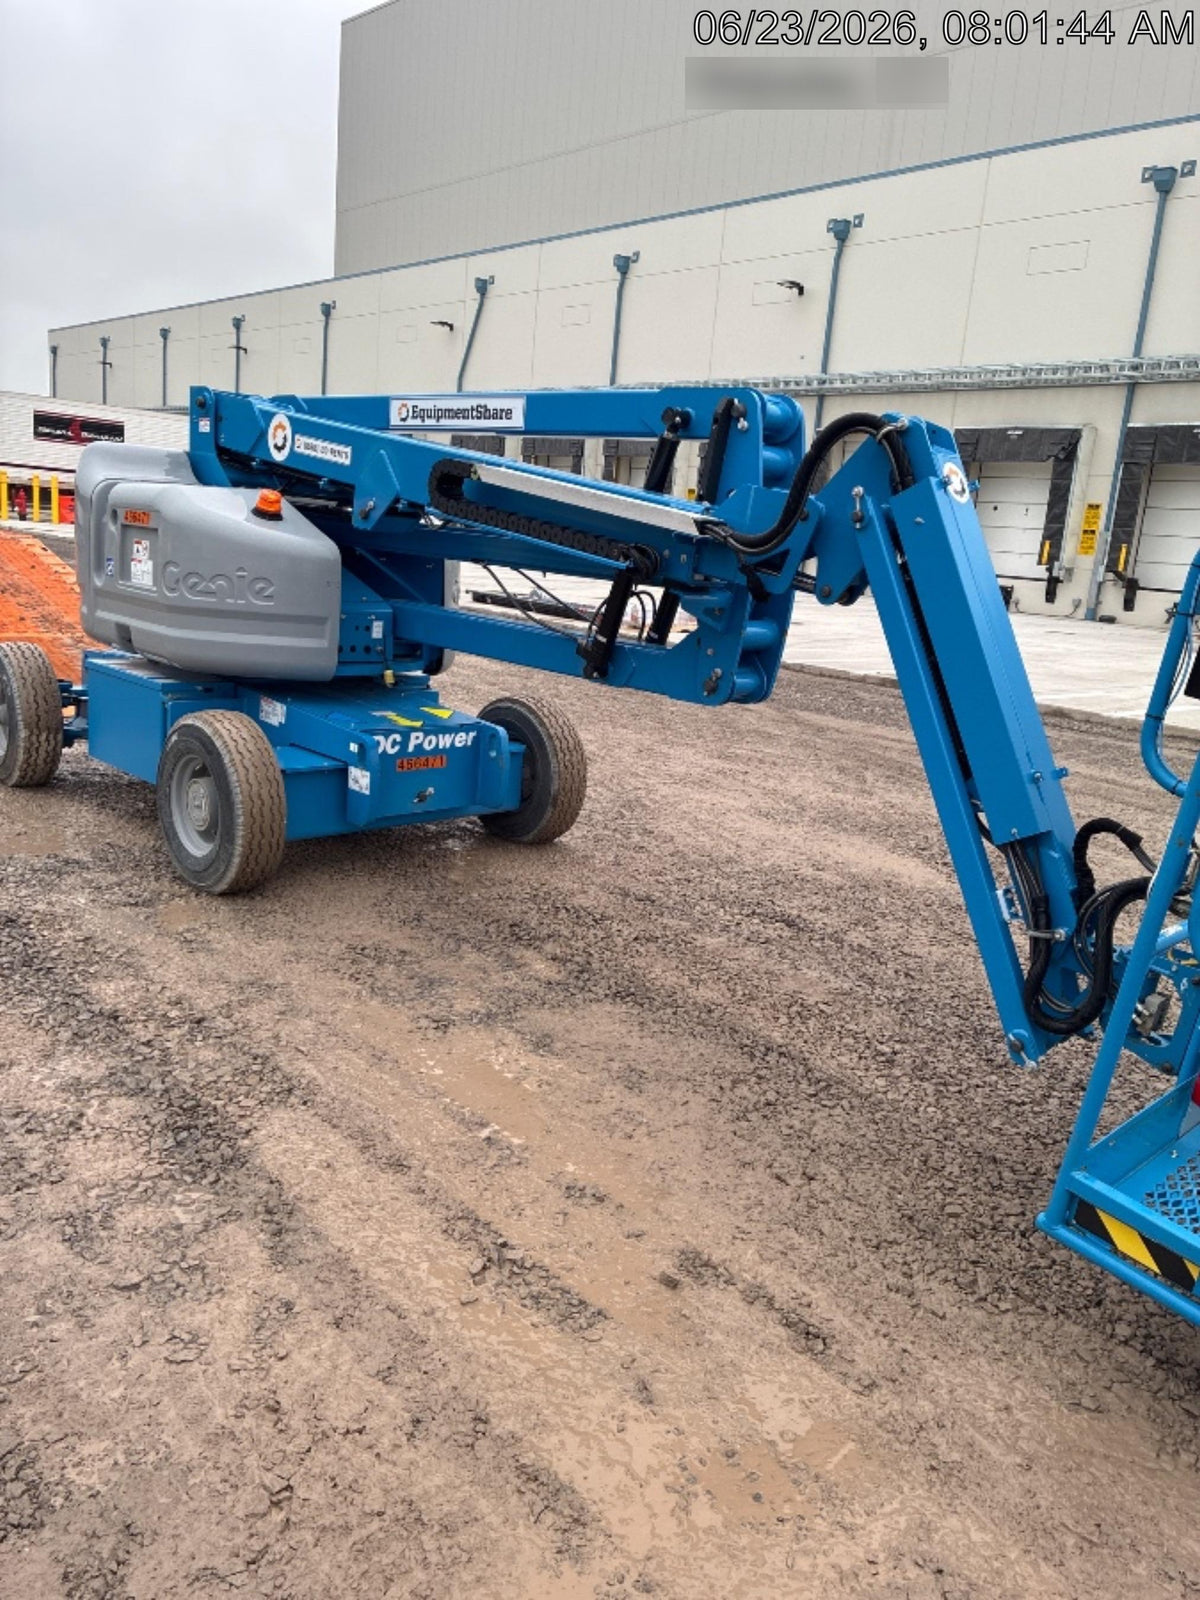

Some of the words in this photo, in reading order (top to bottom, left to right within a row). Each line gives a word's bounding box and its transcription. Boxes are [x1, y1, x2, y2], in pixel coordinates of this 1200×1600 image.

[411, 404, 513, 423] EquipmentShare
[162, 560, 275, 606] Genie
[407, 730, 477, 753] Power
